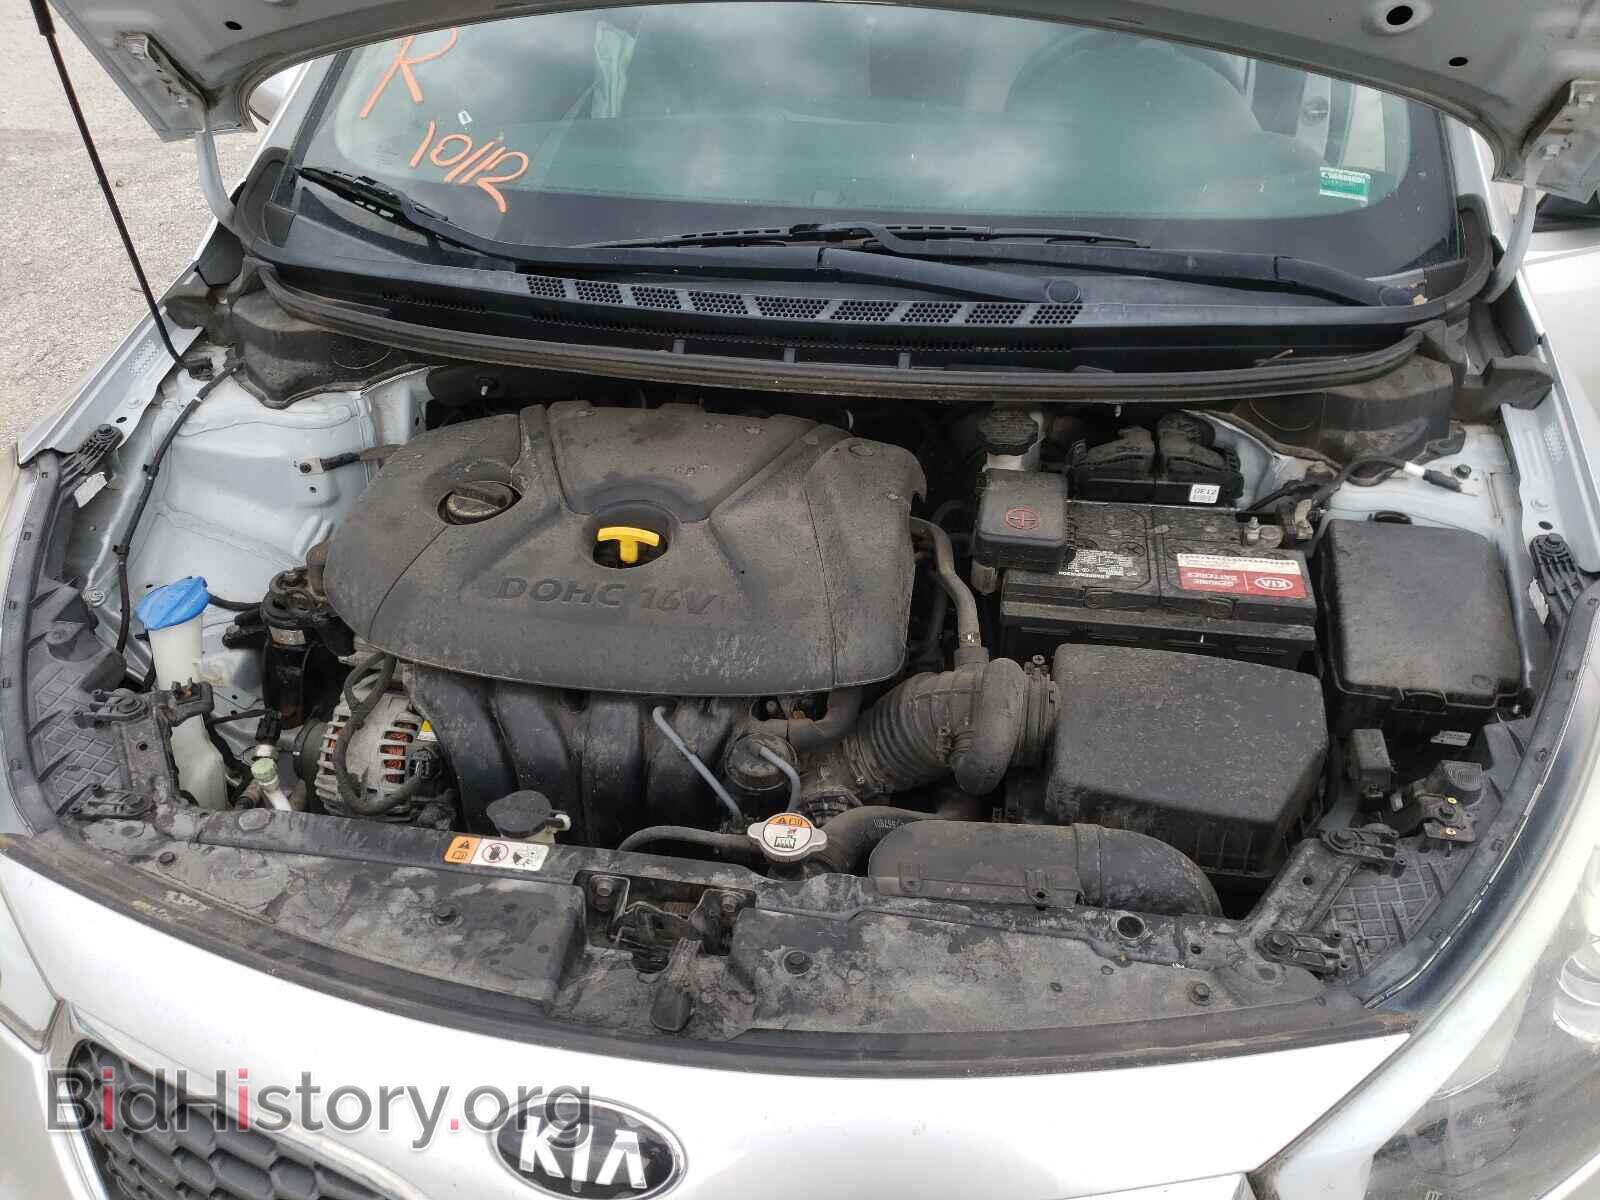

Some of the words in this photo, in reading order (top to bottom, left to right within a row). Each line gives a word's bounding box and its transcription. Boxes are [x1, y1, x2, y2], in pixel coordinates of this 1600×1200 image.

[498, 576, 625, 607] DOHC
[641, 588, 717, 615] 16V
[519, 1115, 647, 1189] KIA
